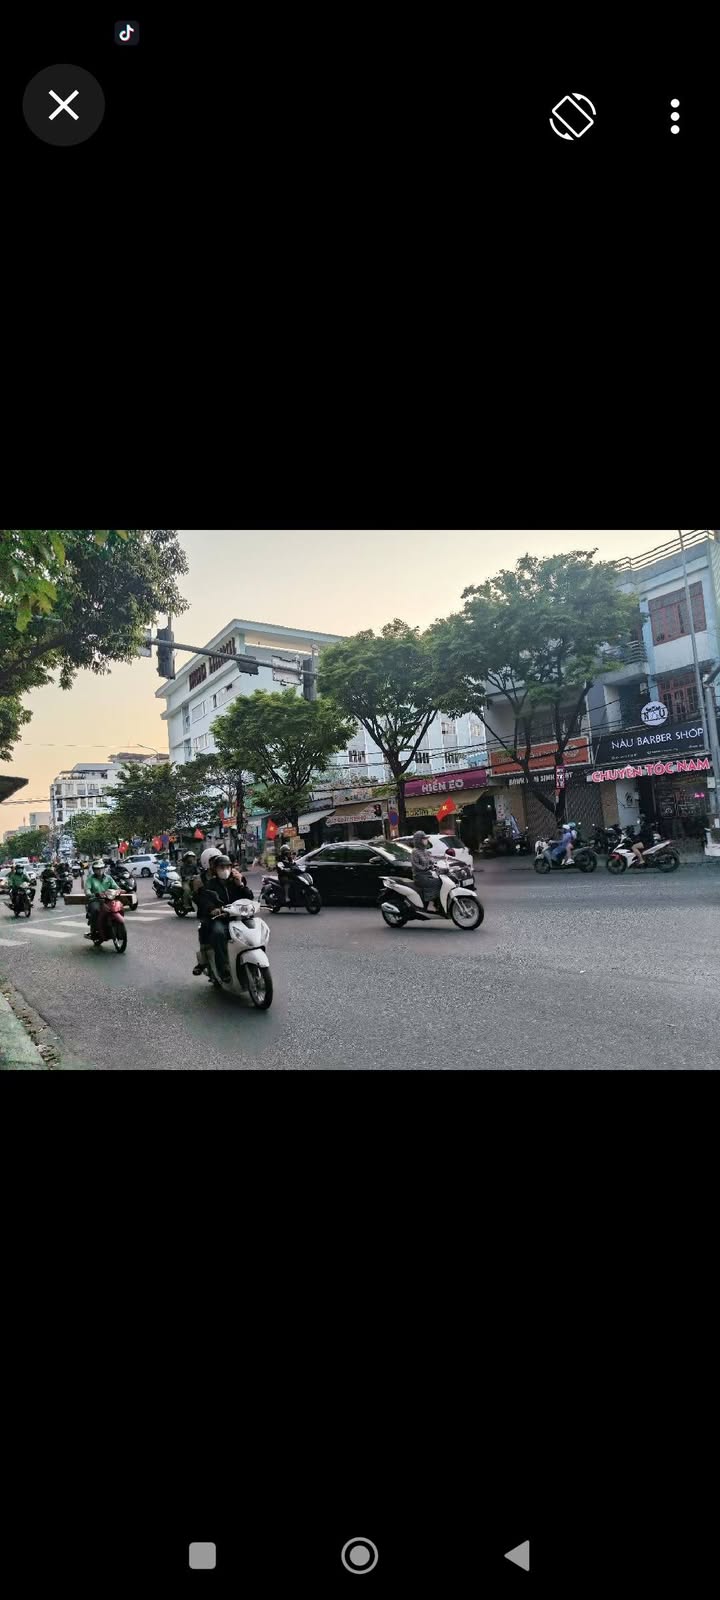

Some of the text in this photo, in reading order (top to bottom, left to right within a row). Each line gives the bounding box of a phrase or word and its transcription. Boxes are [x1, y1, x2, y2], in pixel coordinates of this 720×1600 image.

[637, 732, 673, 746] BARBER
[675, 727, 705, 740] SHOP
[591, 764, 642, 783] CHUYÊN
[645, 760, 674, 776] TÓC
[676, 756, 711, 773] NAM
